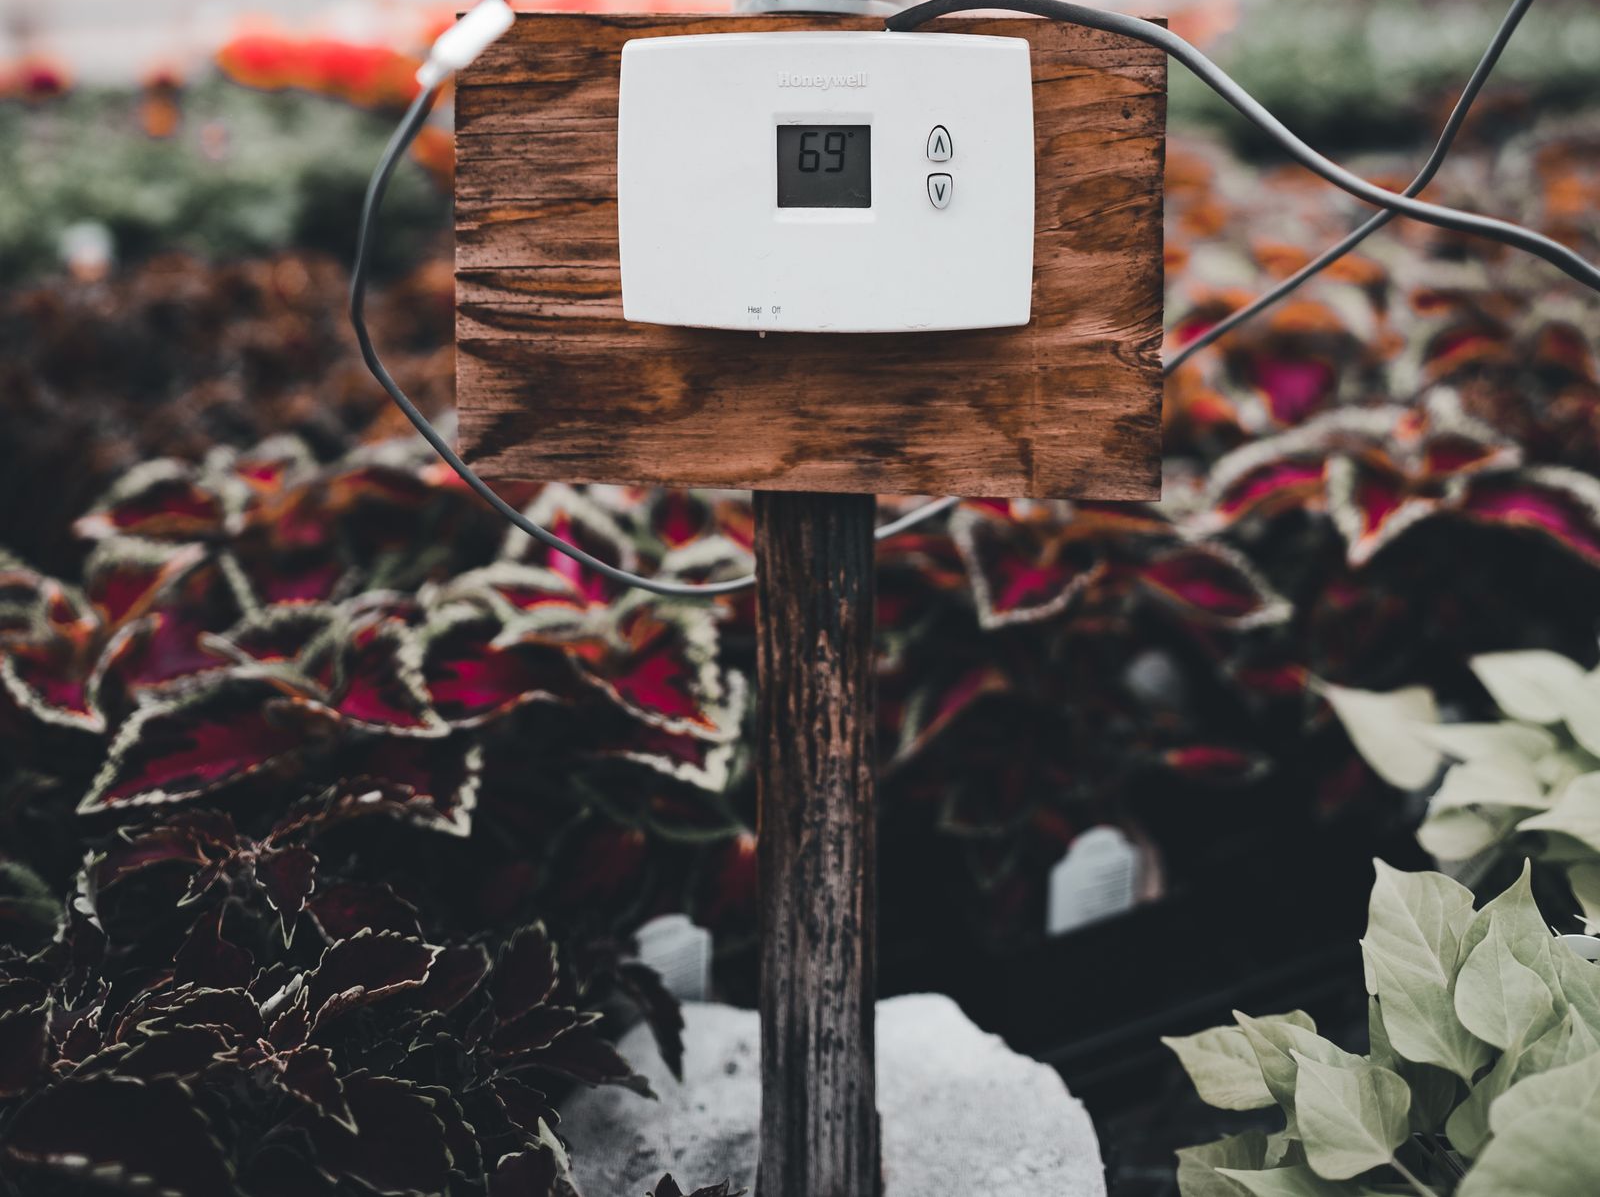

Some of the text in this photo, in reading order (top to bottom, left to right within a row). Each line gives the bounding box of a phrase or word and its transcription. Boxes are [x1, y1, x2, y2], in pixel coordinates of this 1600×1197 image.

[779, 71, 868, 91] Honeywell
[747, 305, 781, 314] Heat Off
